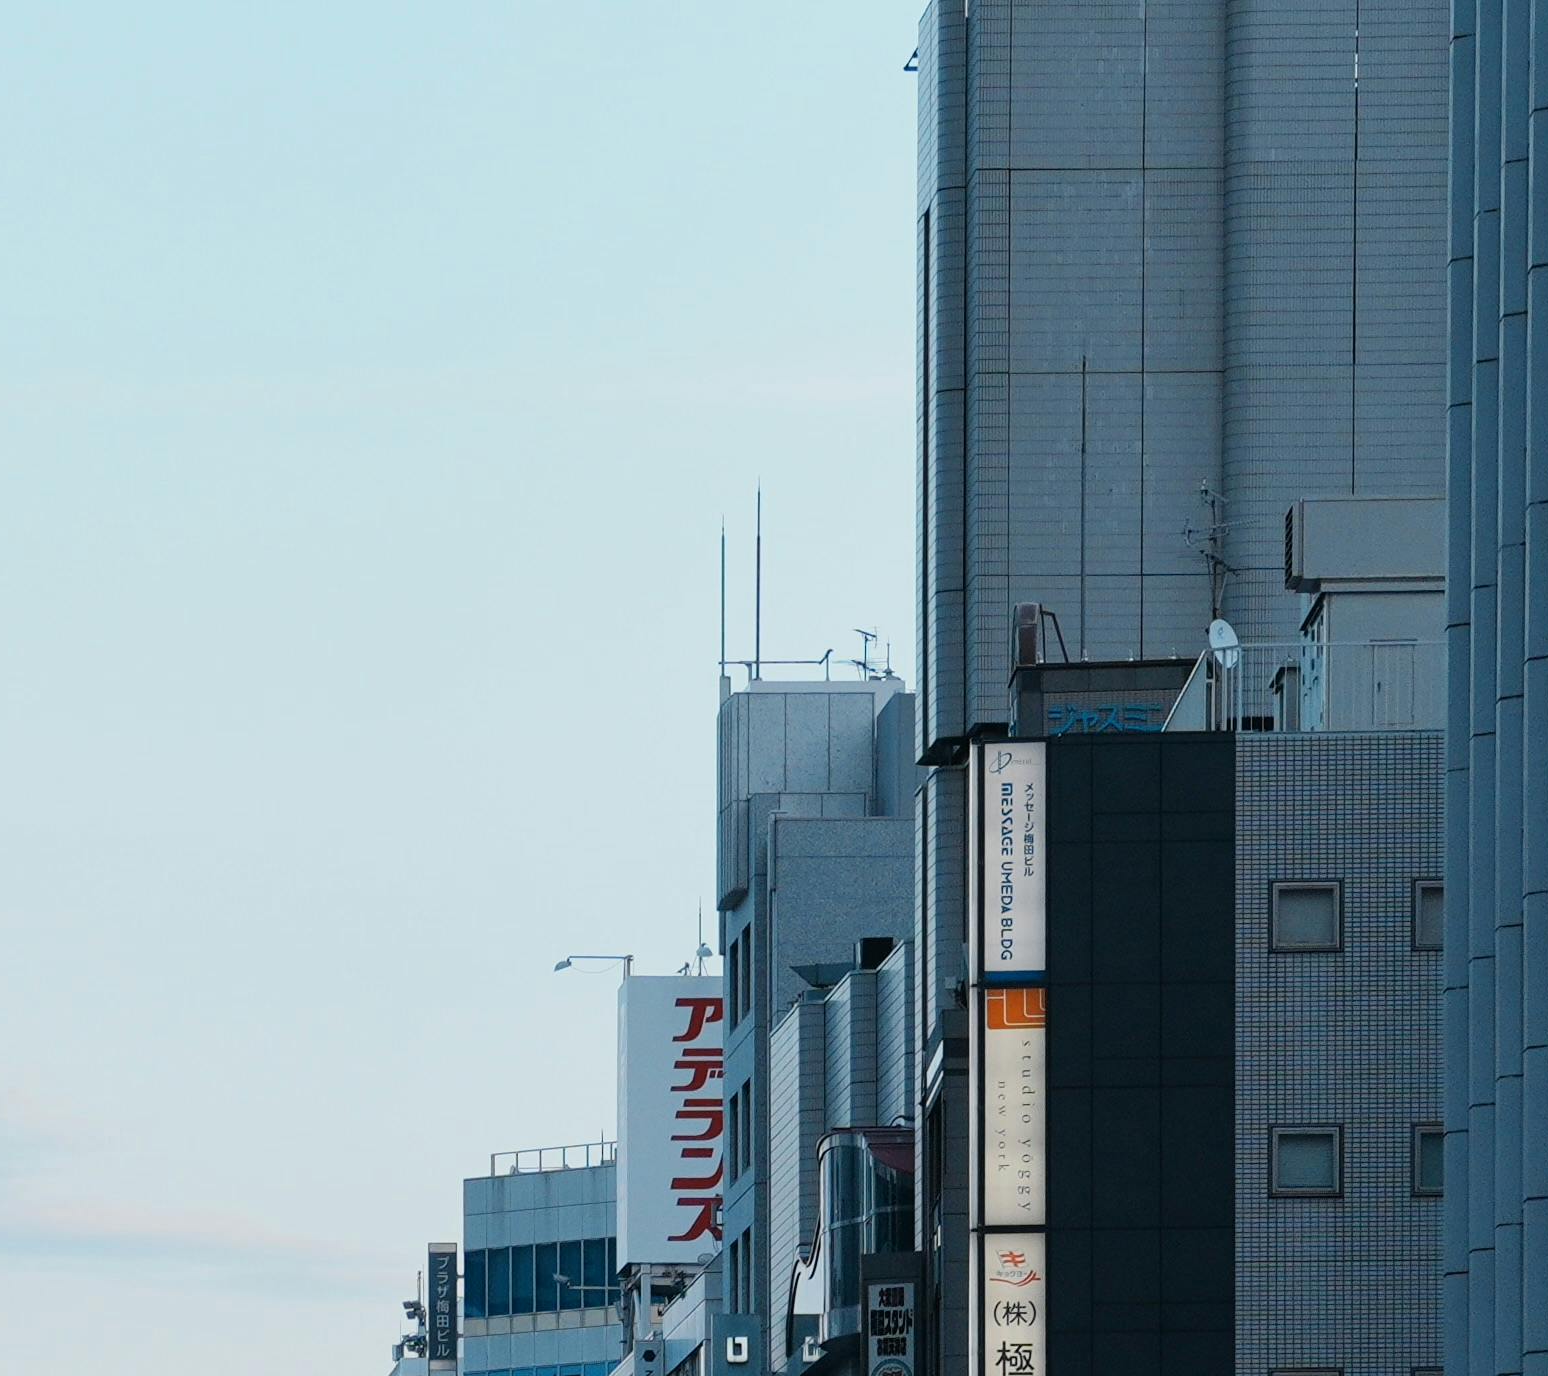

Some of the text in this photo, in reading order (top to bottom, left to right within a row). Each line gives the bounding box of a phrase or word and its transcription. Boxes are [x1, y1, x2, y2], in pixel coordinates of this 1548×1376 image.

[1001, 783, 1013, 961] MESSAGE UMEDA BLDG
[1023, 783, 1034, 876] メッセージ梅田ビル
[668, 998, 723, 1241] アデランス
[996, 1081, 1011, 1173] new york
[1021, 1040, 1032, 1123] studio
[436, 1256, 450, 1358] プラザ梅田ビル
